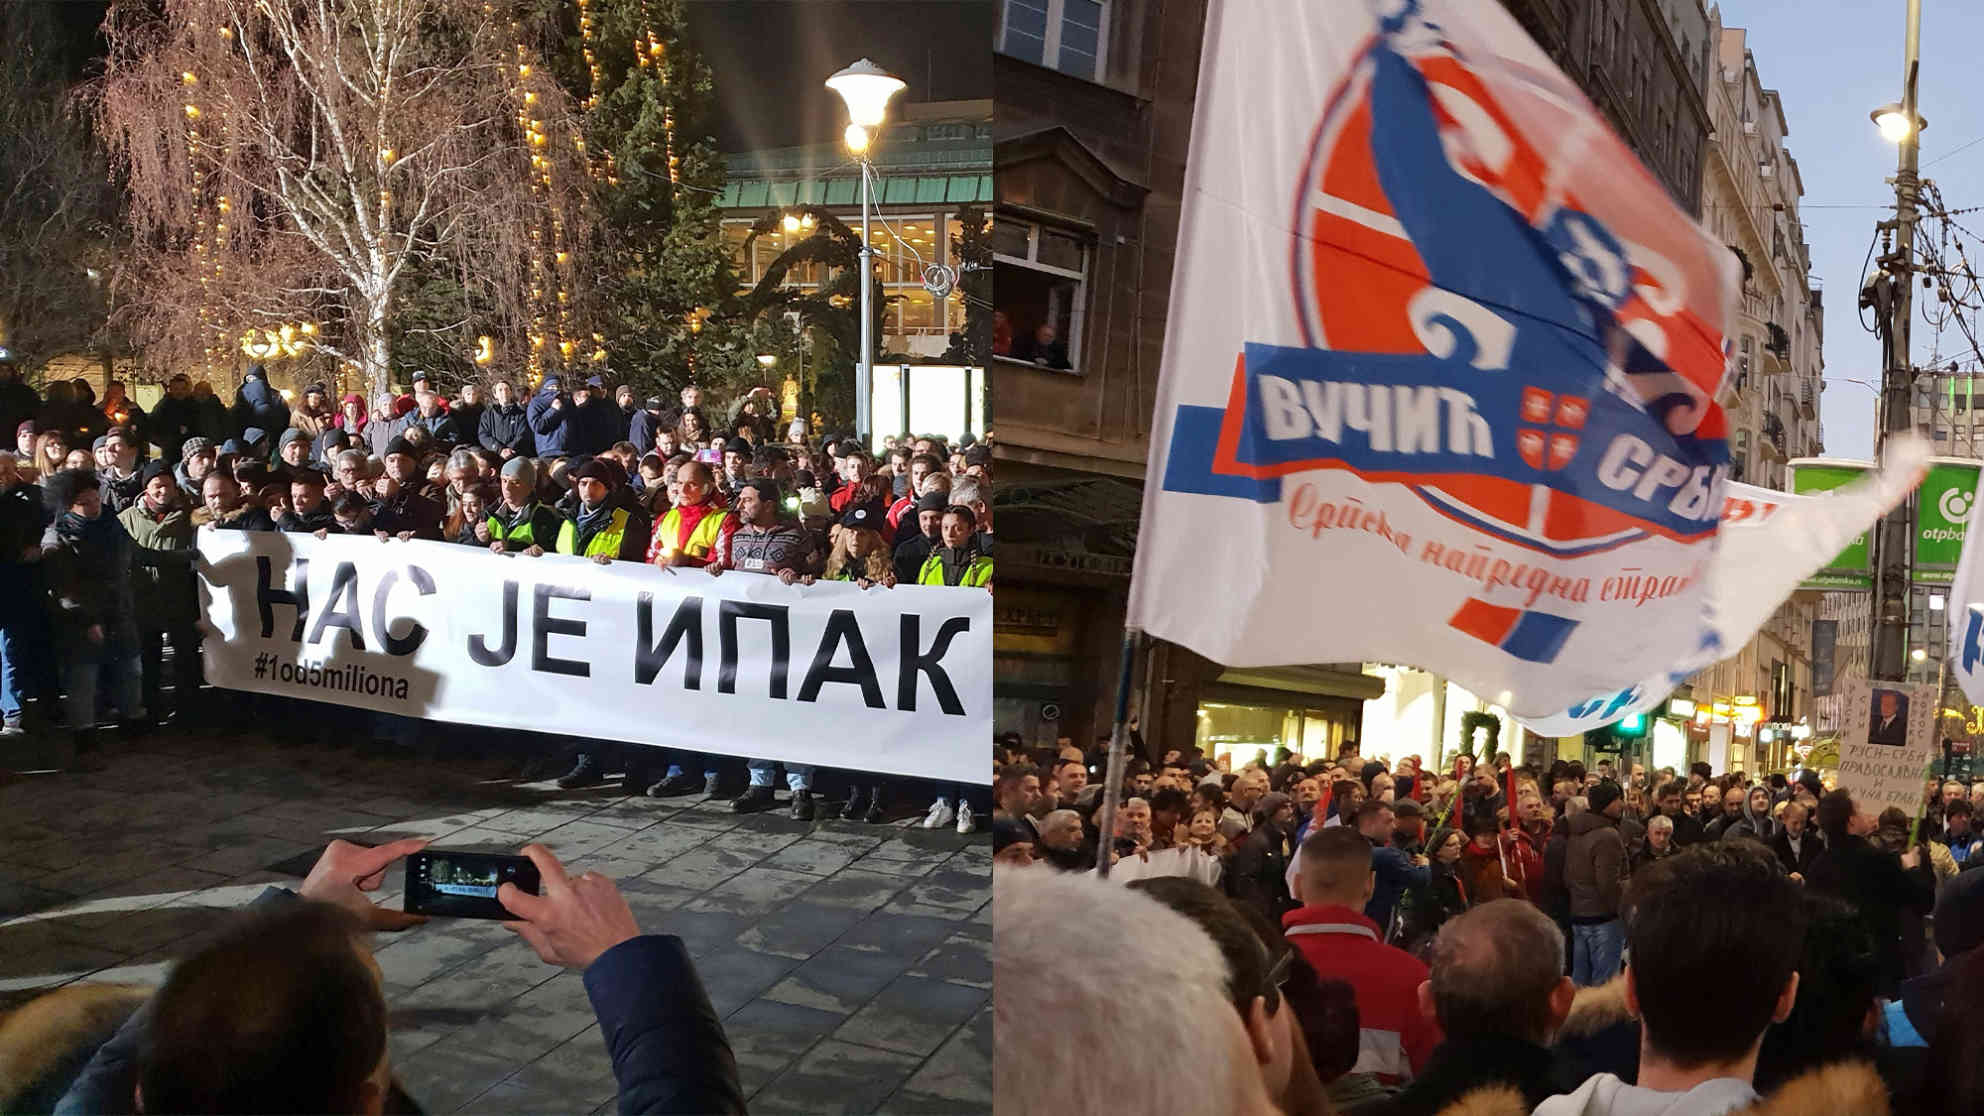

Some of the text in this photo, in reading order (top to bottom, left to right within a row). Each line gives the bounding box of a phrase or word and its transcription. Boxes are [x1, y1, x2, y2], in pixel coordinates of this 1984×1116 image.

[1258, 373, 1496, 460] ВУЧИЋ
[1923, 526, 1966, 543] otpba
[255, 555, 971, 717] НАС ЈЕ ИПАК
[254, 651, 409, 700] #1od5miliona
